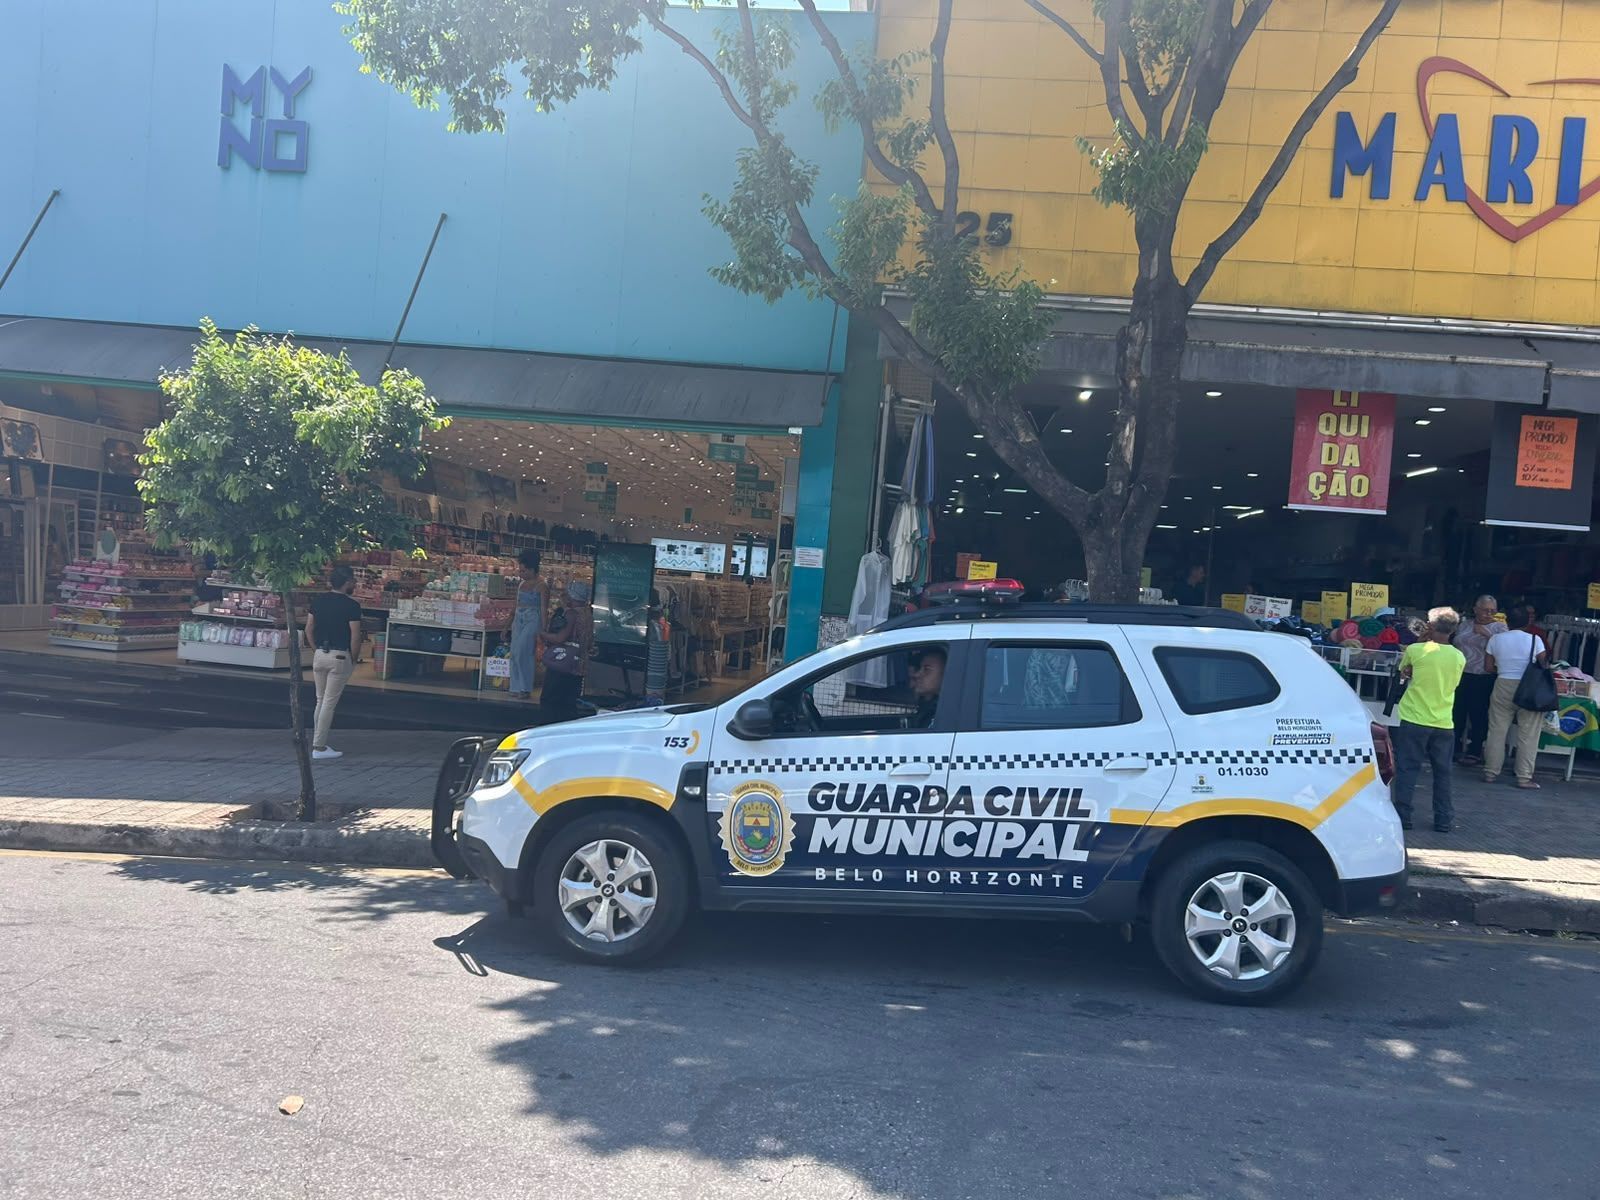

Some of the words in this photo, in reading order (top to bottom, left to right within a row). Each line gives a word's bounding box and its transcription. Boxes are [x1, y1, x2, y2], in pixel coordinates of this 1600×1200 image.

[220, 62, 313, 119] MY
[217, 118, 309, 174] NO
[1330, 111, 1586, 206] MARI
[1332, 389, 1359, 408] LI
[1318, 412, 1370, 438] QUI
[1320, 442, 1361, 467] DA
[1308, 469, 1370, 500] ÇÃO
[1275, 718, 1321, 726] PREFEITURA
[664, 736, 690, 748] 153
[1218, 766, 1269, 776] 01.1030
[807, 781, 976, 815] GUARDA
[984, 786, 1092, 818] CIVIL
[807, 817, 1090, 862] MUNICIPAL
[906, 869, 1084, 889] HORIZONTE
